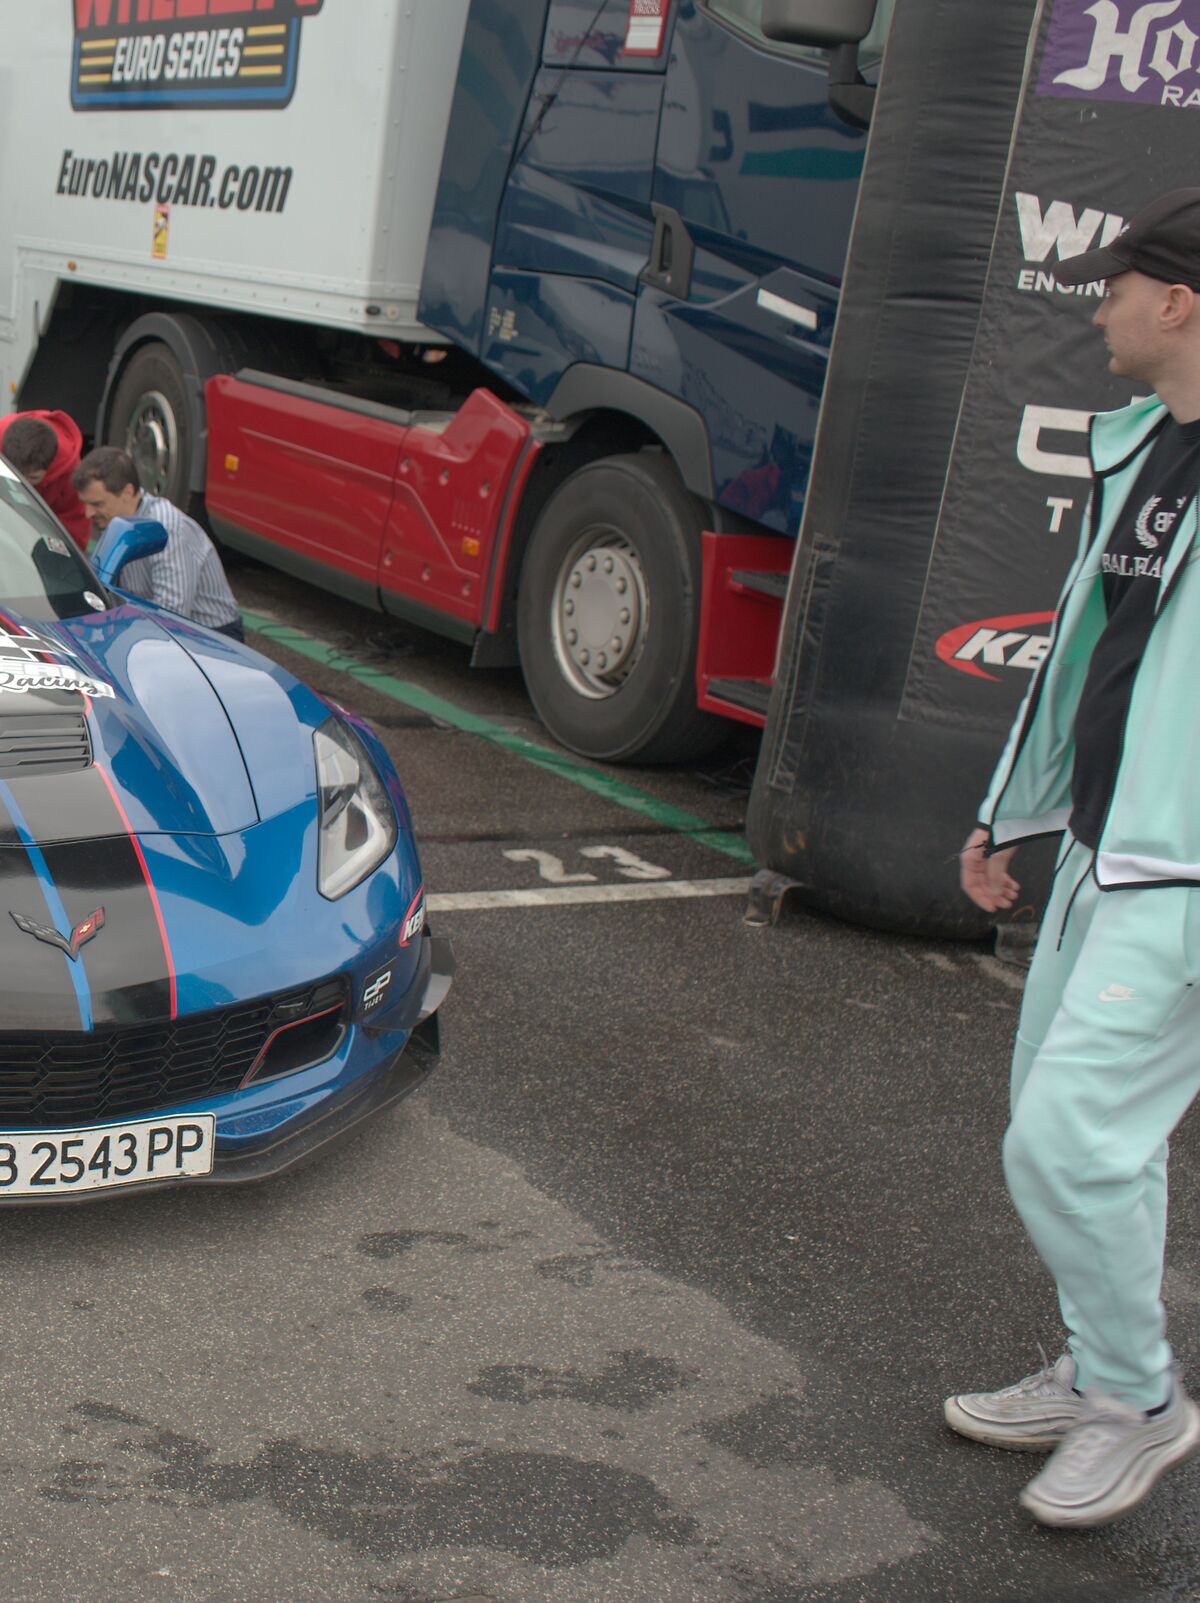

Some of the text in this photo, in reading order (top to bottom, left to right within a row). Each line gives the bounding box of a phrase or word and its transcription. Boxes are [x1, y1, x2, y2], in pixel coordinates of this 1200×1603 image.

[111, 27, 244, 83] EURO SERIES
[1052, 0, 1200, 93] Ho
[56, 149, 293, 213] EuroNASCAR.com
[501, 845, 672, 884] 23
[402, 904, 425, 942] KE
[29, 1132, 138, 1186] 2543
[147, 1123, 203, 1172] PP
